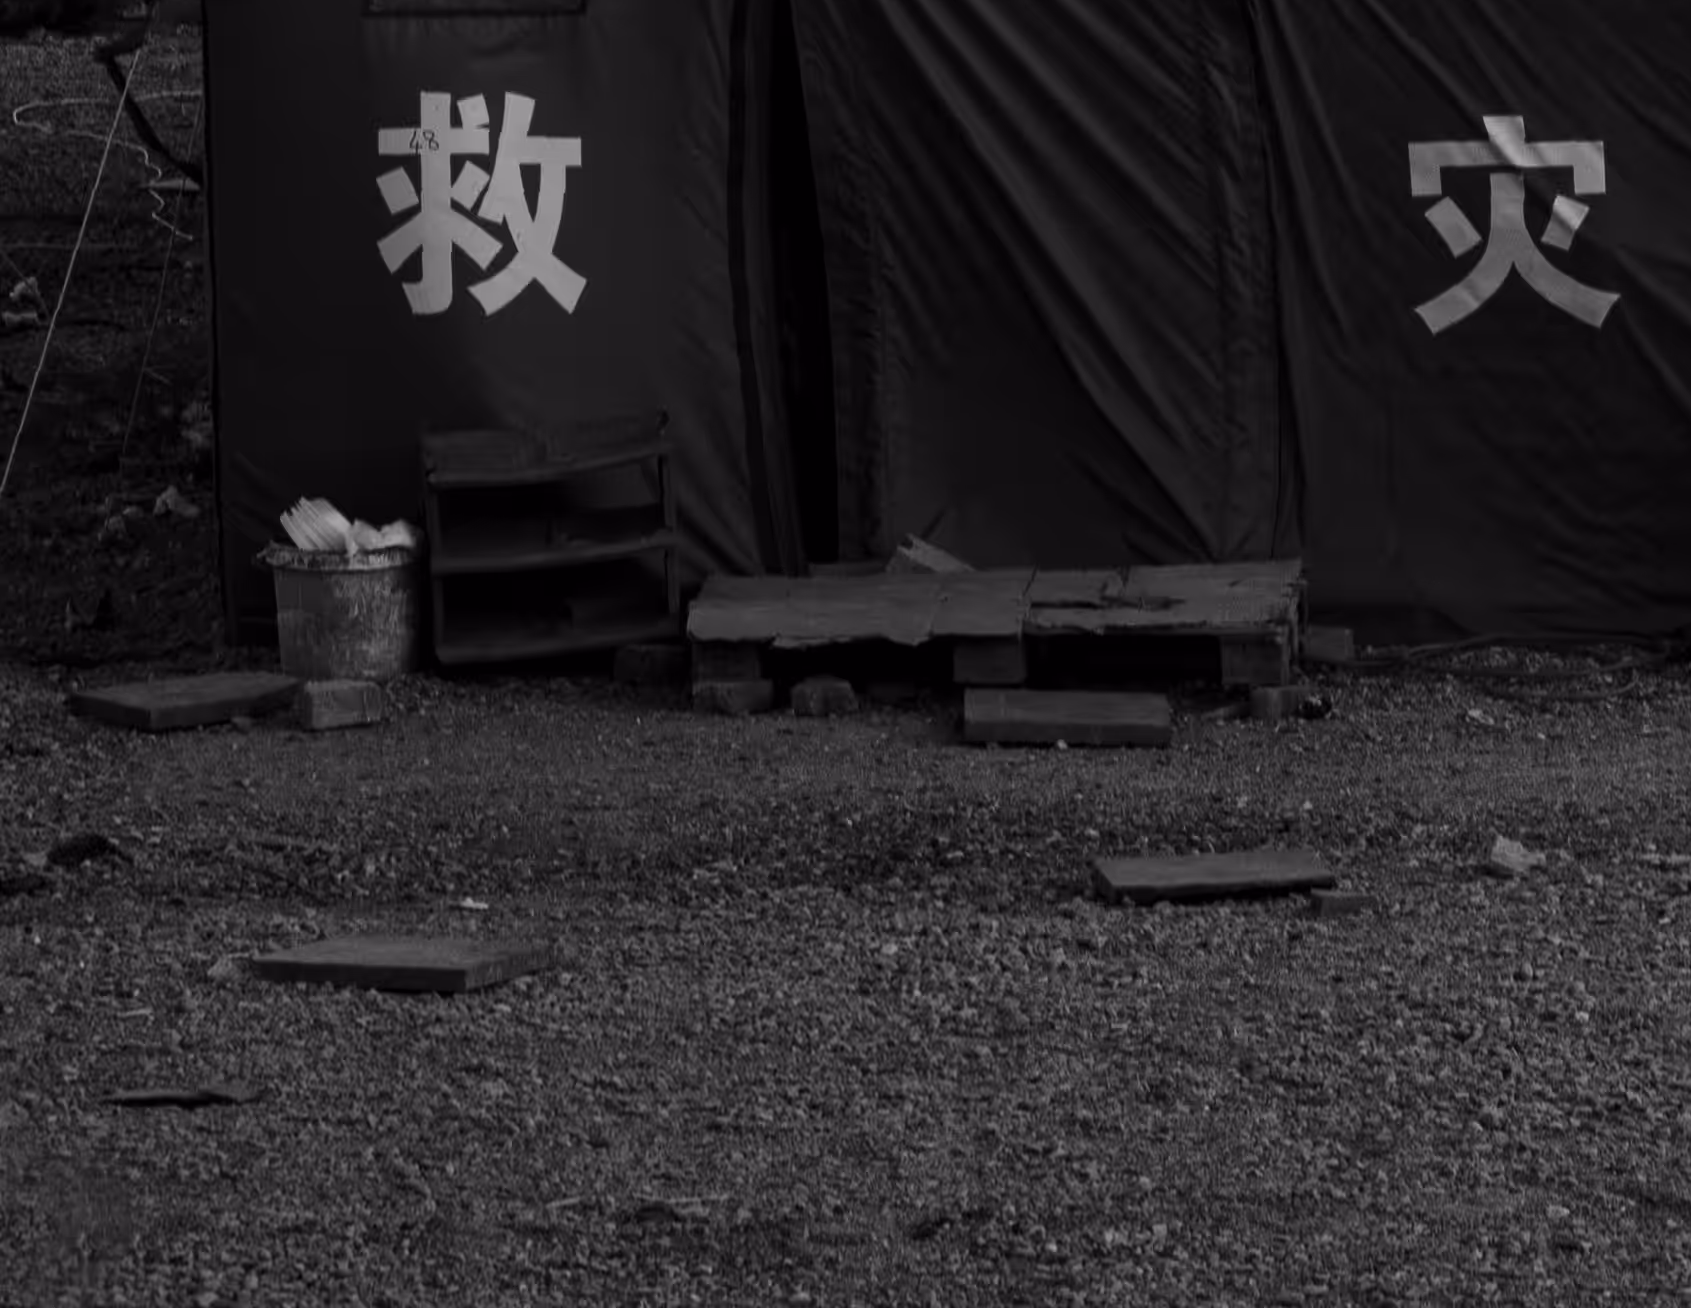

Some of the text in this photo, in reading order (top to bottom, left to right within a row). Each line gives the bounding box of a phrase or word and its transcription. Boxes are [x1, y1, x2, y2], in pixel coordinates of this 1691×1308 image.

[409, 129, 440, 154] 48
[376, 90, 1621, 335] 救 灾
